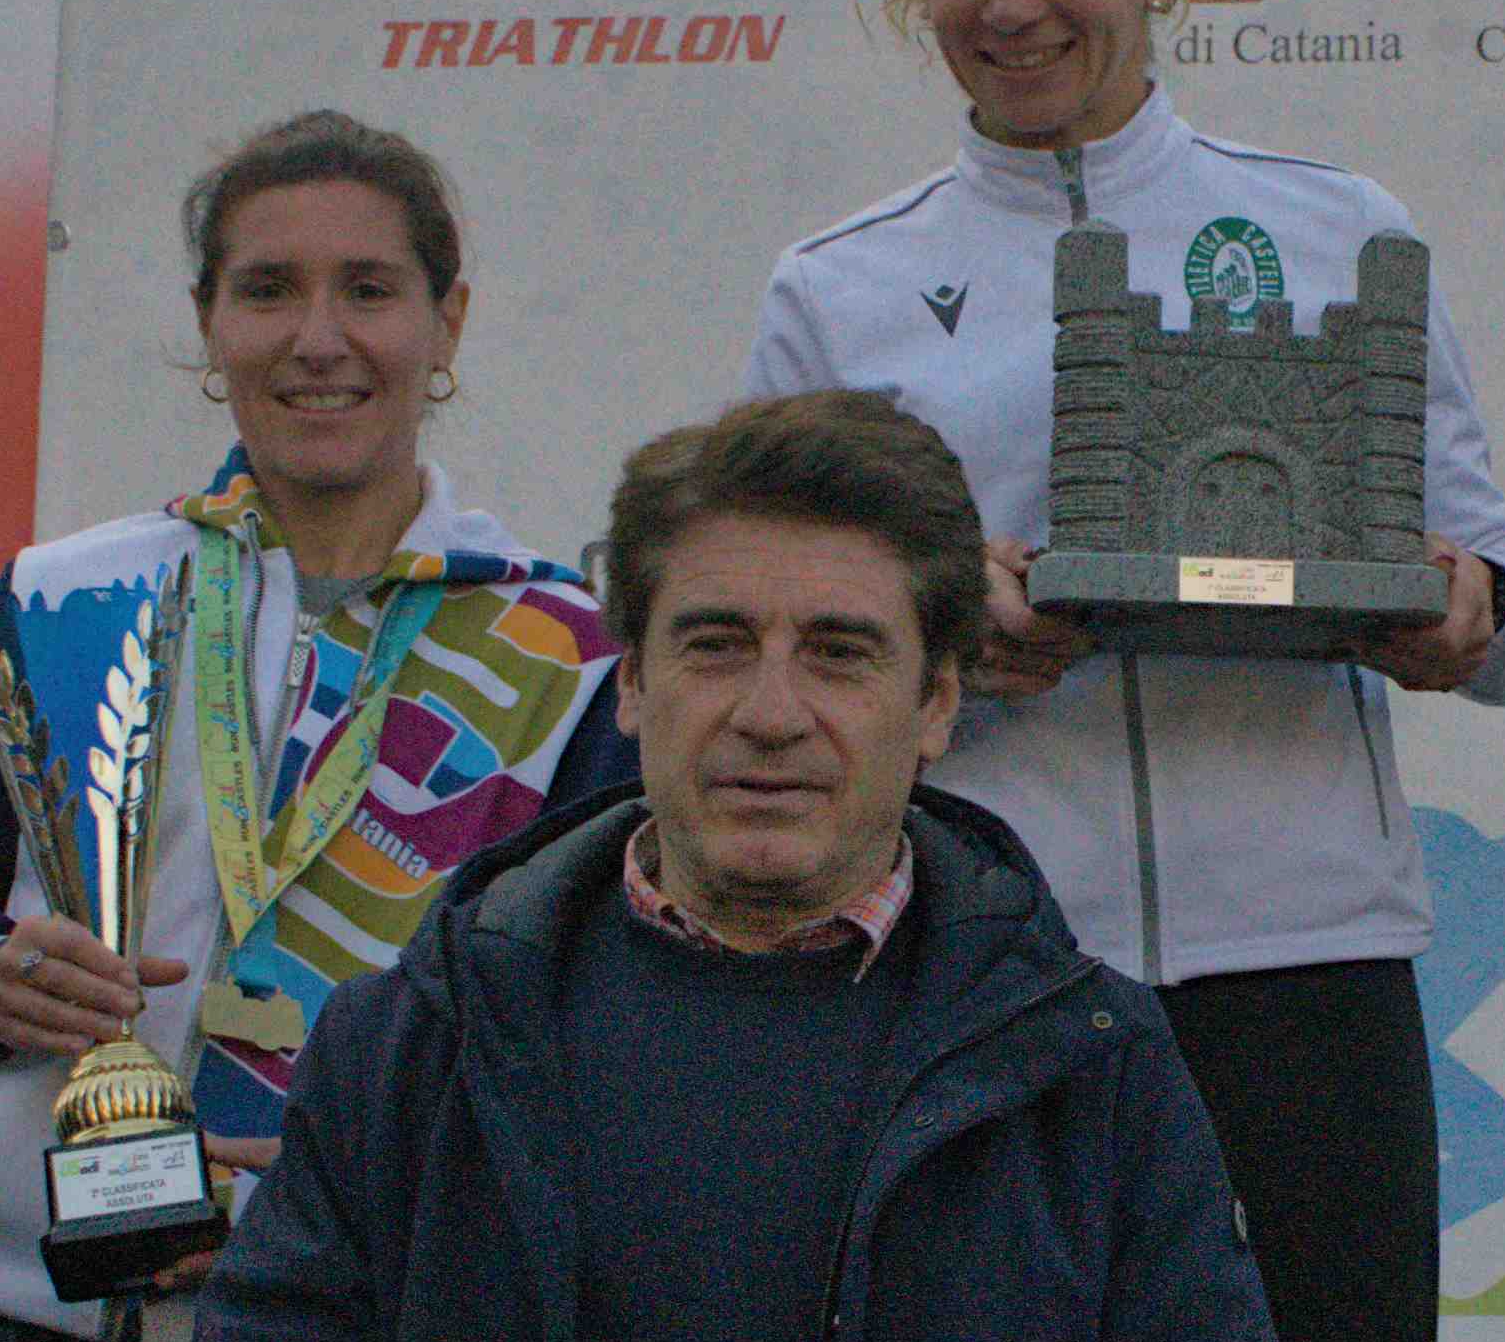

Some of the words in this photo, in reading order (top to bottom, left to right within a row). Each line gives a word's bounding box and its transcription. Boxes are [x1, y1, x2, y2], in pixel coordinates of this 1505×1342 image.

[380, 14, 786, 70] TRIATHLON
[1174, 22, 1217, 65] di
[1232, 19, 1404, 62] Catania
[350, 805, 433, 880] tania
